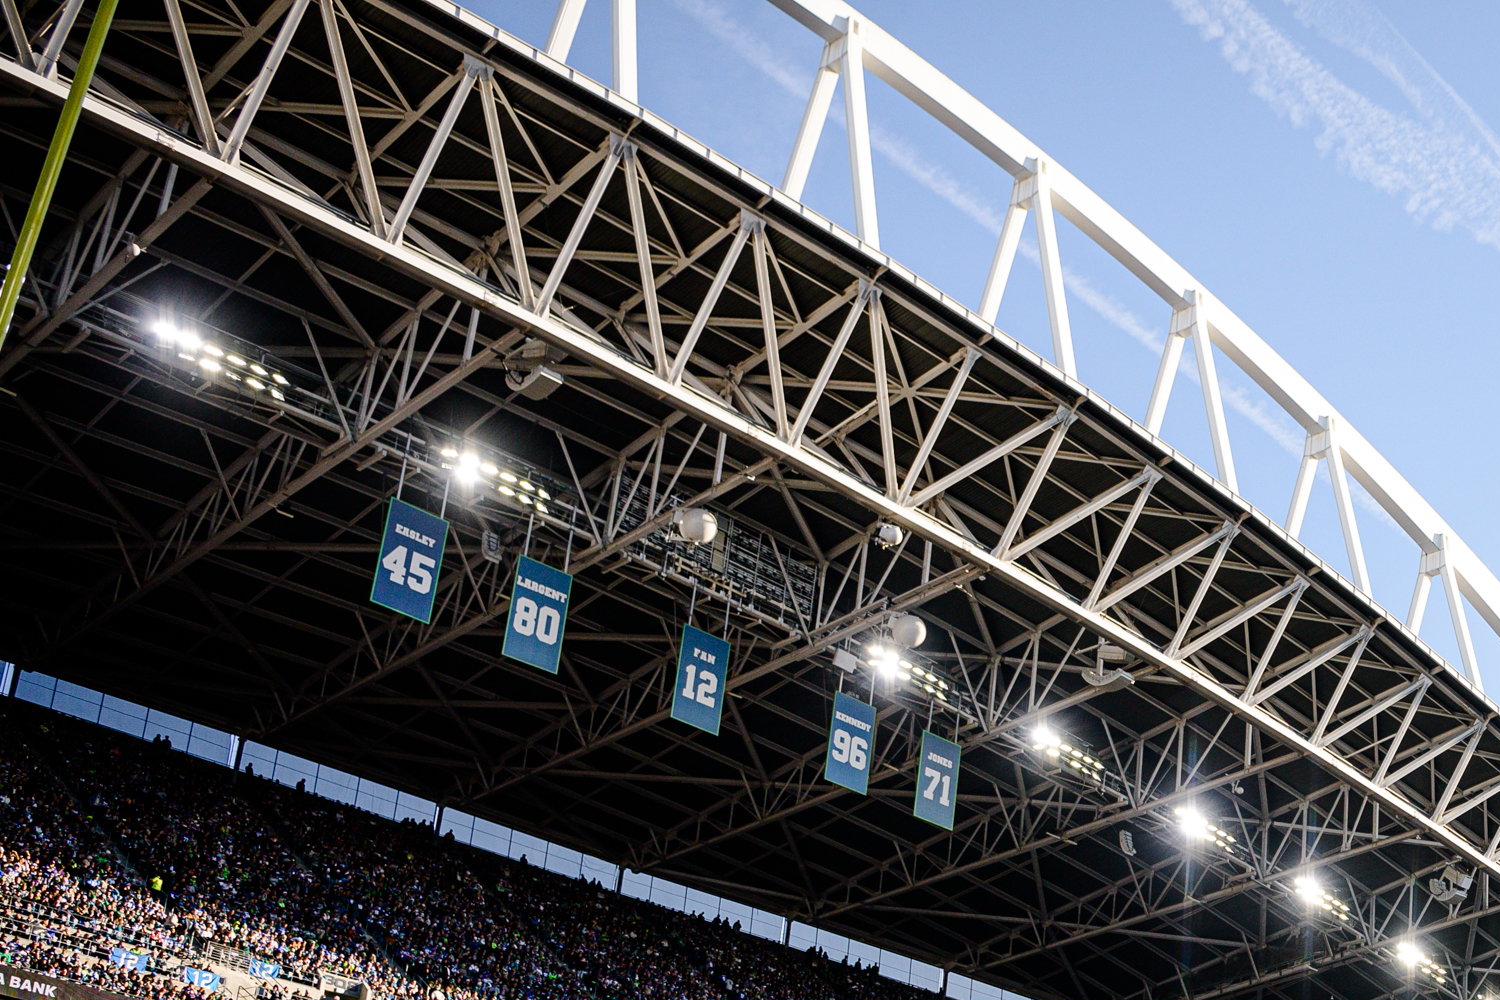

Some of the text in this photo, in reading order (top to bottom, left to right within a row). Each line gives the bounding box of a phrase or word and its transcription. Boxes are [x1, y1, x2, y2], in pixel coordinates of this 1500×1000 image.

[396, 523, 436, 548] EASLEY
[382, 545, 436, 595] 45
[517, 575, 567, 603] LARGENT
[513, 596, 560, 645] 80
[693, 647, 716, 665] FAN
[682, 664, 718, 708] 12
[835, 711, 871, 733] KENNEDY
[832, 728, 867, 771] 96
[927, 752, 953, 769] JONES
[923, 767, 950, 807] 71
[9, 975, 56, 998] BANK
[193, 971, 212, 989] 12
